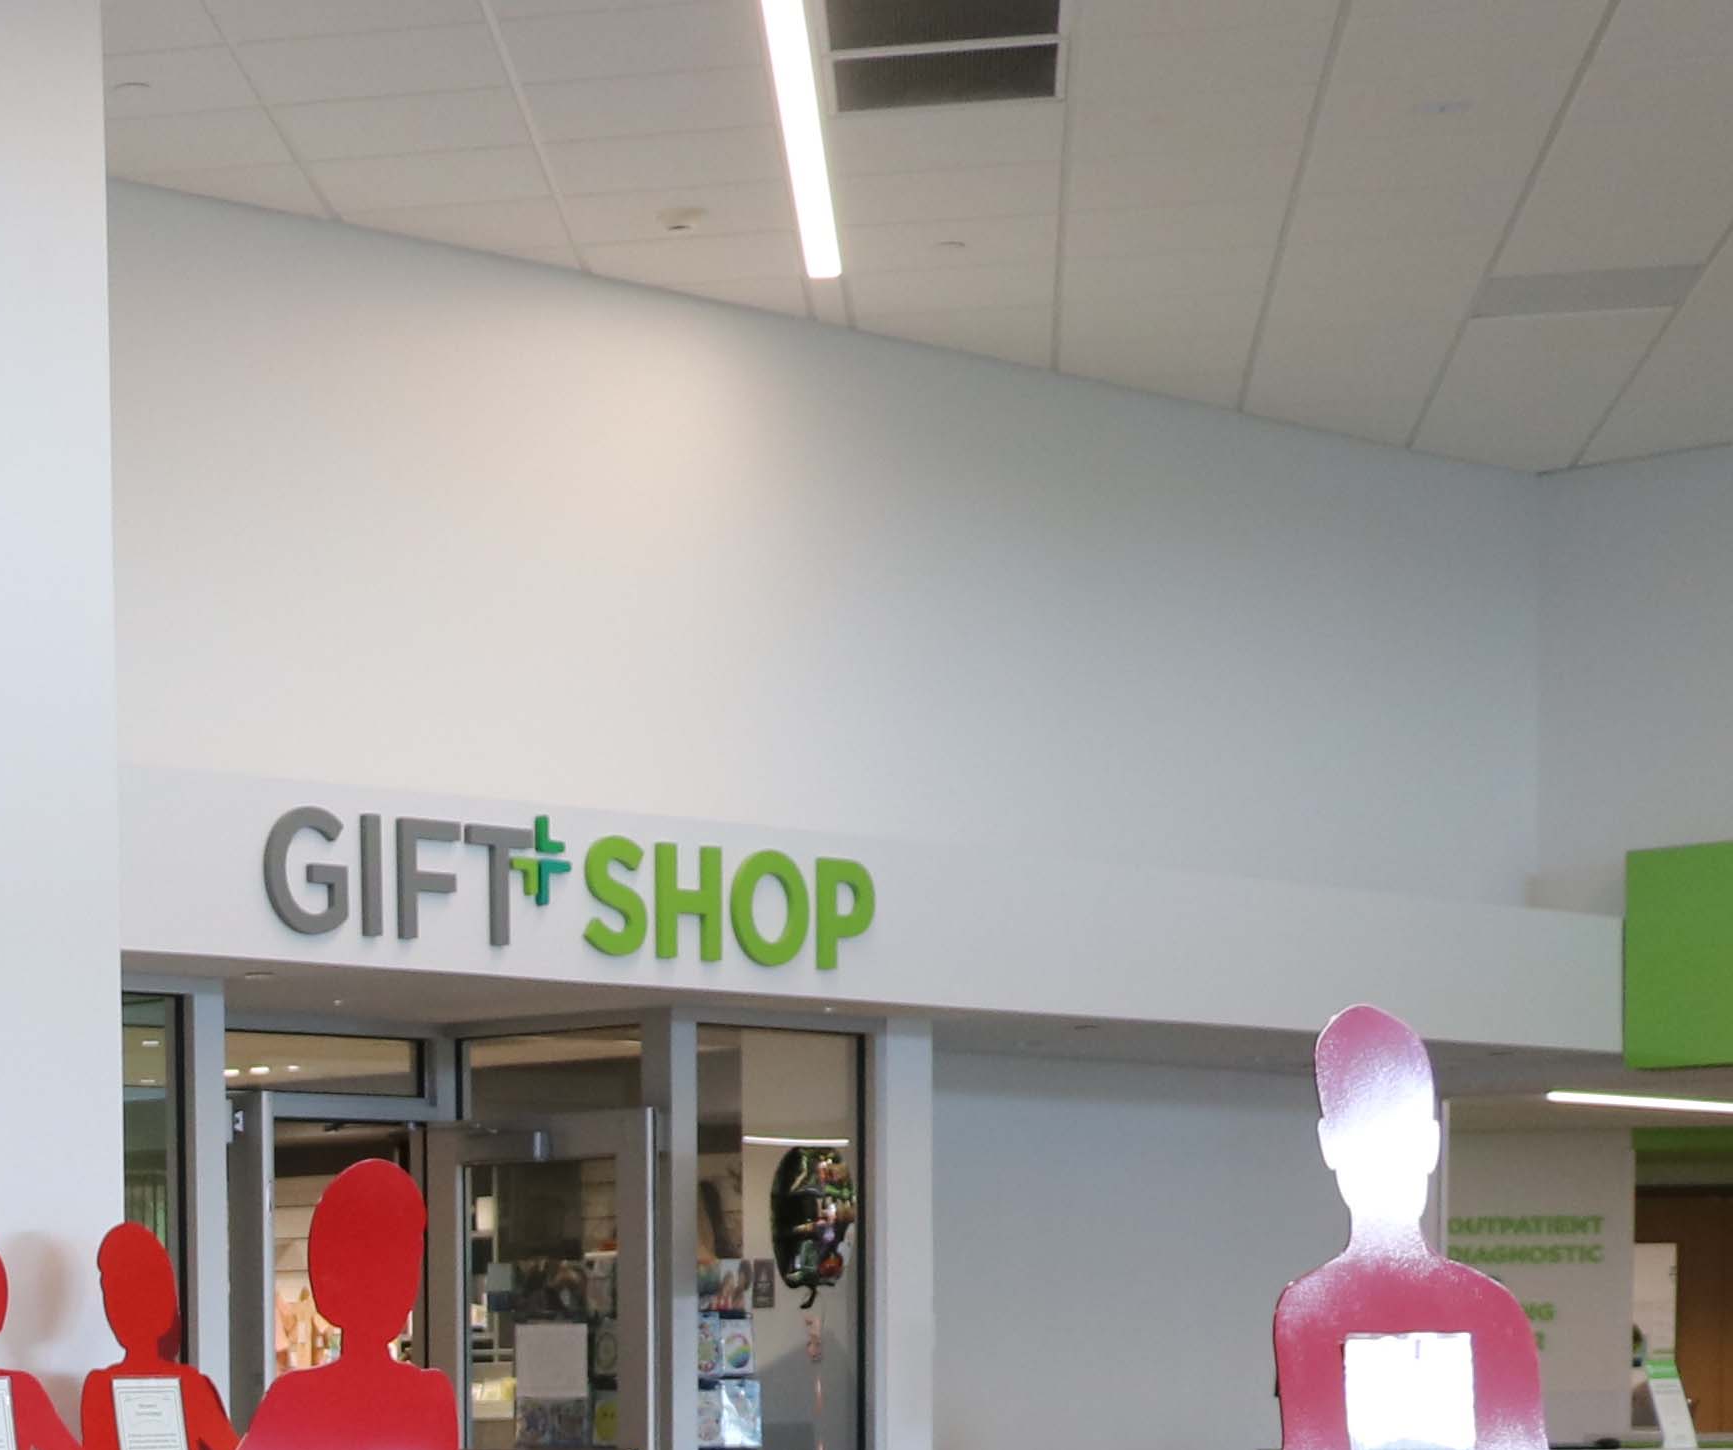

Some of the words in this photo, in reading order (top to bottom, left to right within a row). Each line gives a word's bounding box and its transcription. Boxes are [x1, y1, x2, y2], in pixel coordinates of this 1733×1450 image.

[263, 805, 533, 946] GIFT
[583, 835, 875, 970] SHOP
[1448, 1216, 1604, 1234] OUTPATIENT
[1448, 1245, 1604, 1264] DIAGNOSTIC
